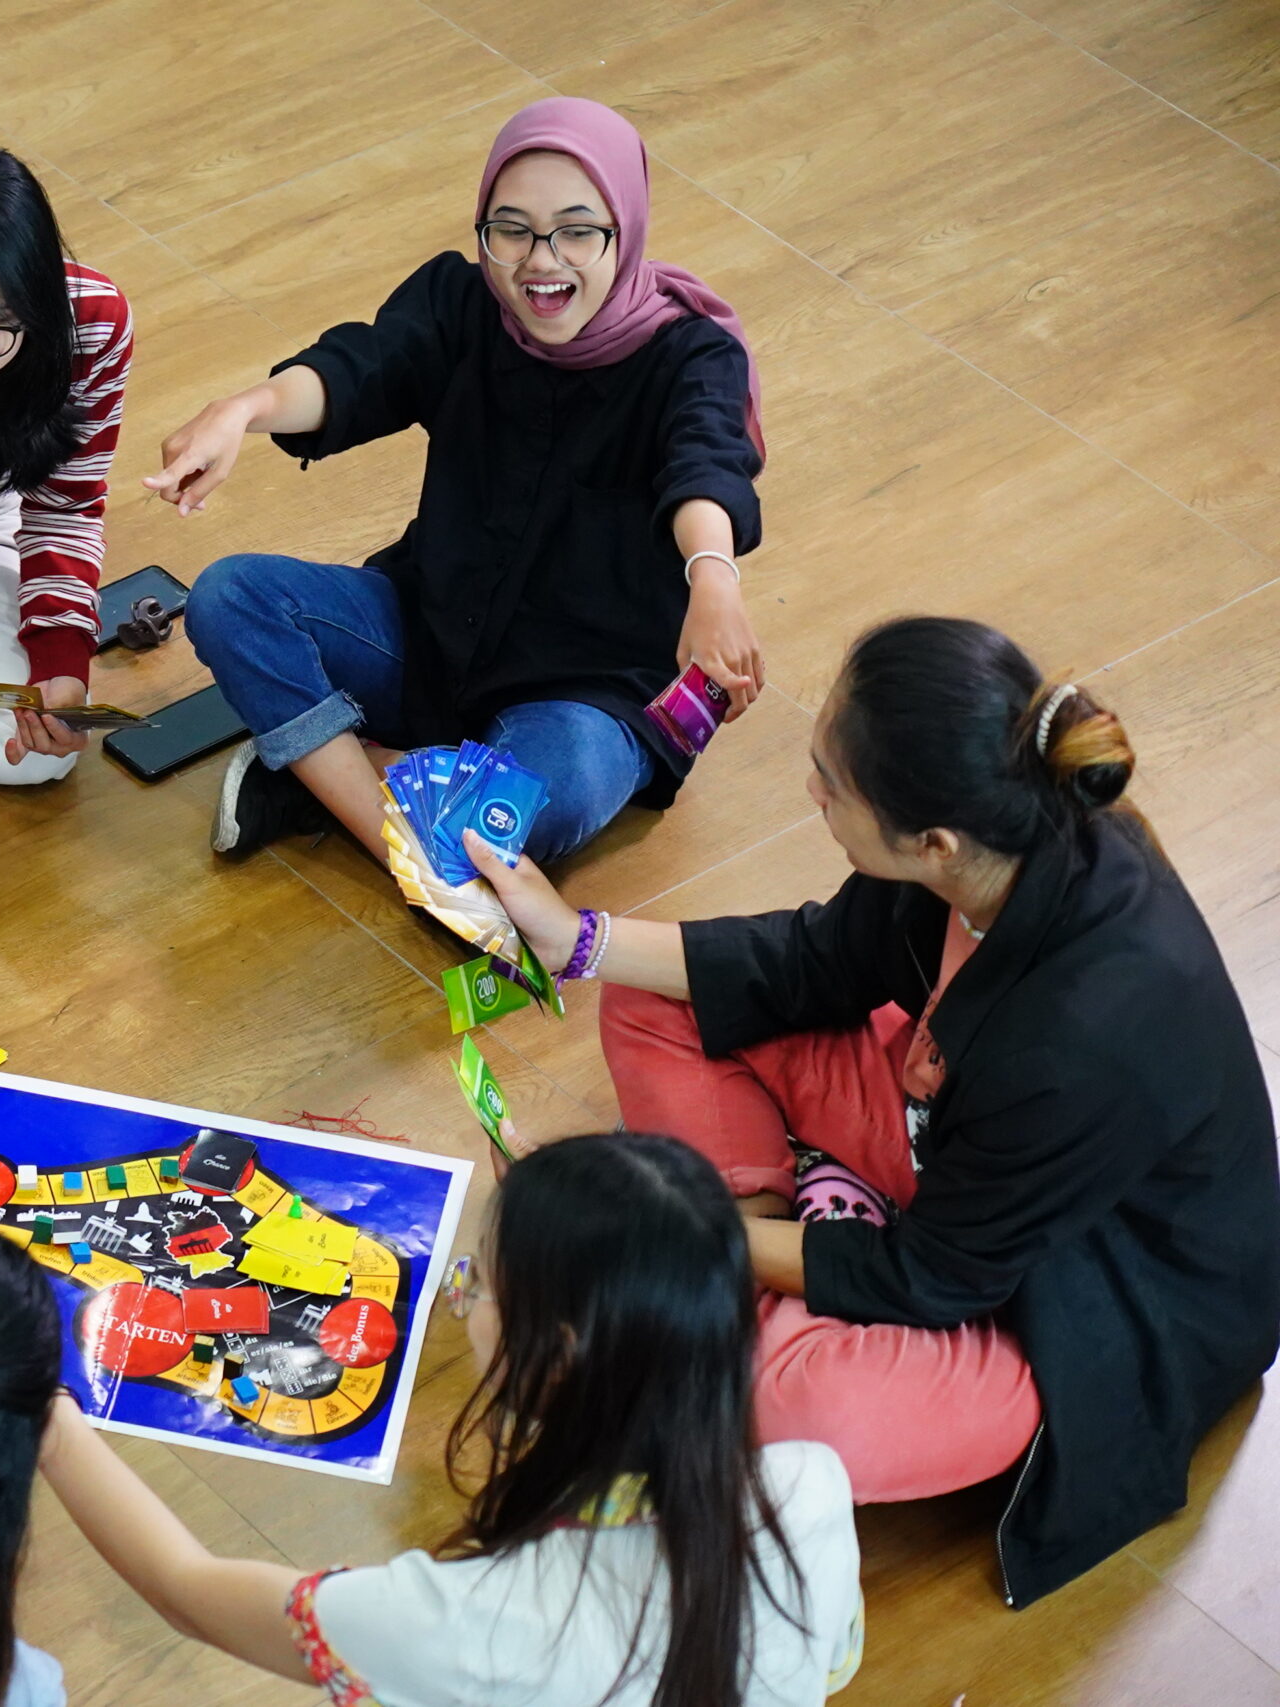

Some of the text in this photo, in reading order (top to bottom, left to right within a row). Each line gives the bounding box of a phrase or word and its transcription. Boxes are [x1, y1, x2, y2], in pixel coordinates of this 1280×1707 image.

[487, 807, 509, 829] 50
[476, 975, 496, 999] 200
[100, 1315, 188, 1346] TARTEN
[245, 1336, 259, 1345] du
[346, 1305, 369, 1362] der Bonus
